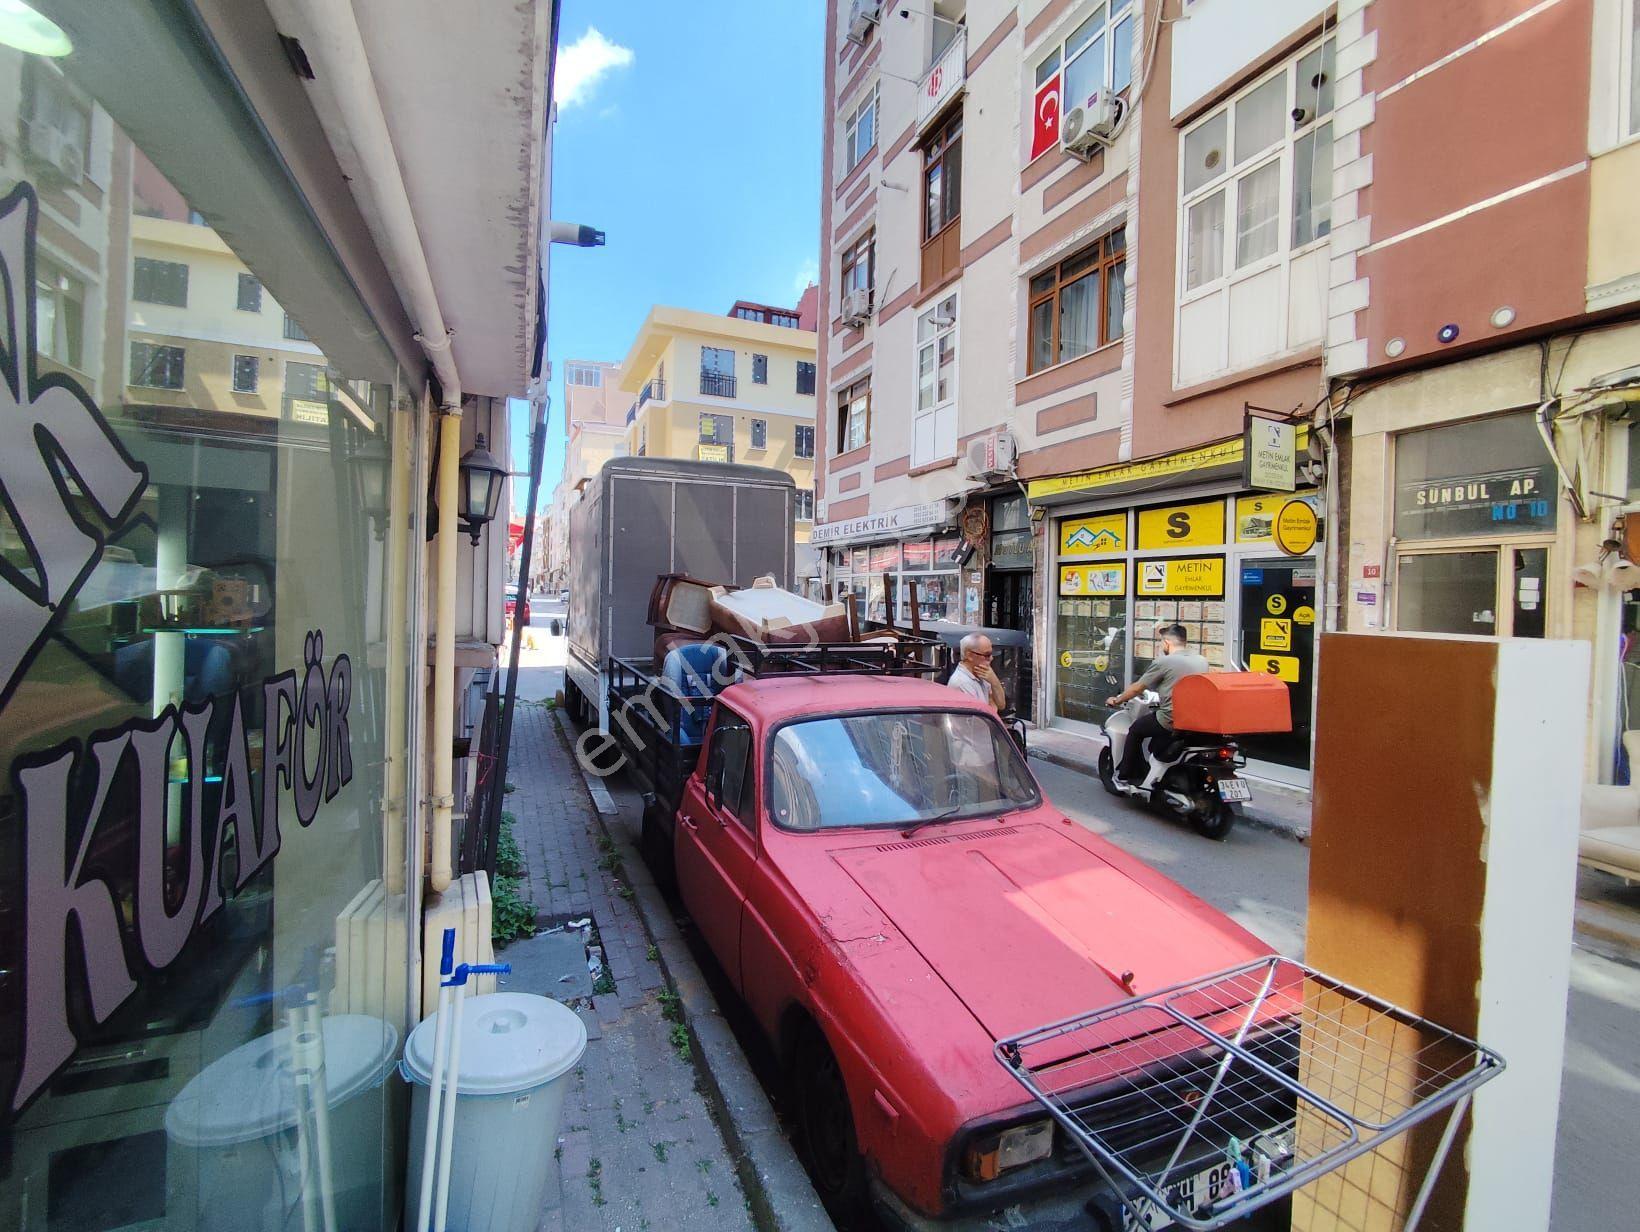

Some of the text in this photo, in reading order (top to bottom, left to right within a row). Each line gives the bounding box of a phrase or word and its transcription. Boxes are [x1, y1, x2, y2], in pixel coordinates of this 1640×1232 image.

[1254, 502, 1263, 511] S
[1166, 511, 1191, 538] S
[1271, 596, 1281, 608] S
[1266, 659, 1280, 674] S
[10, 628, 352, 1113] KUAFÖR
